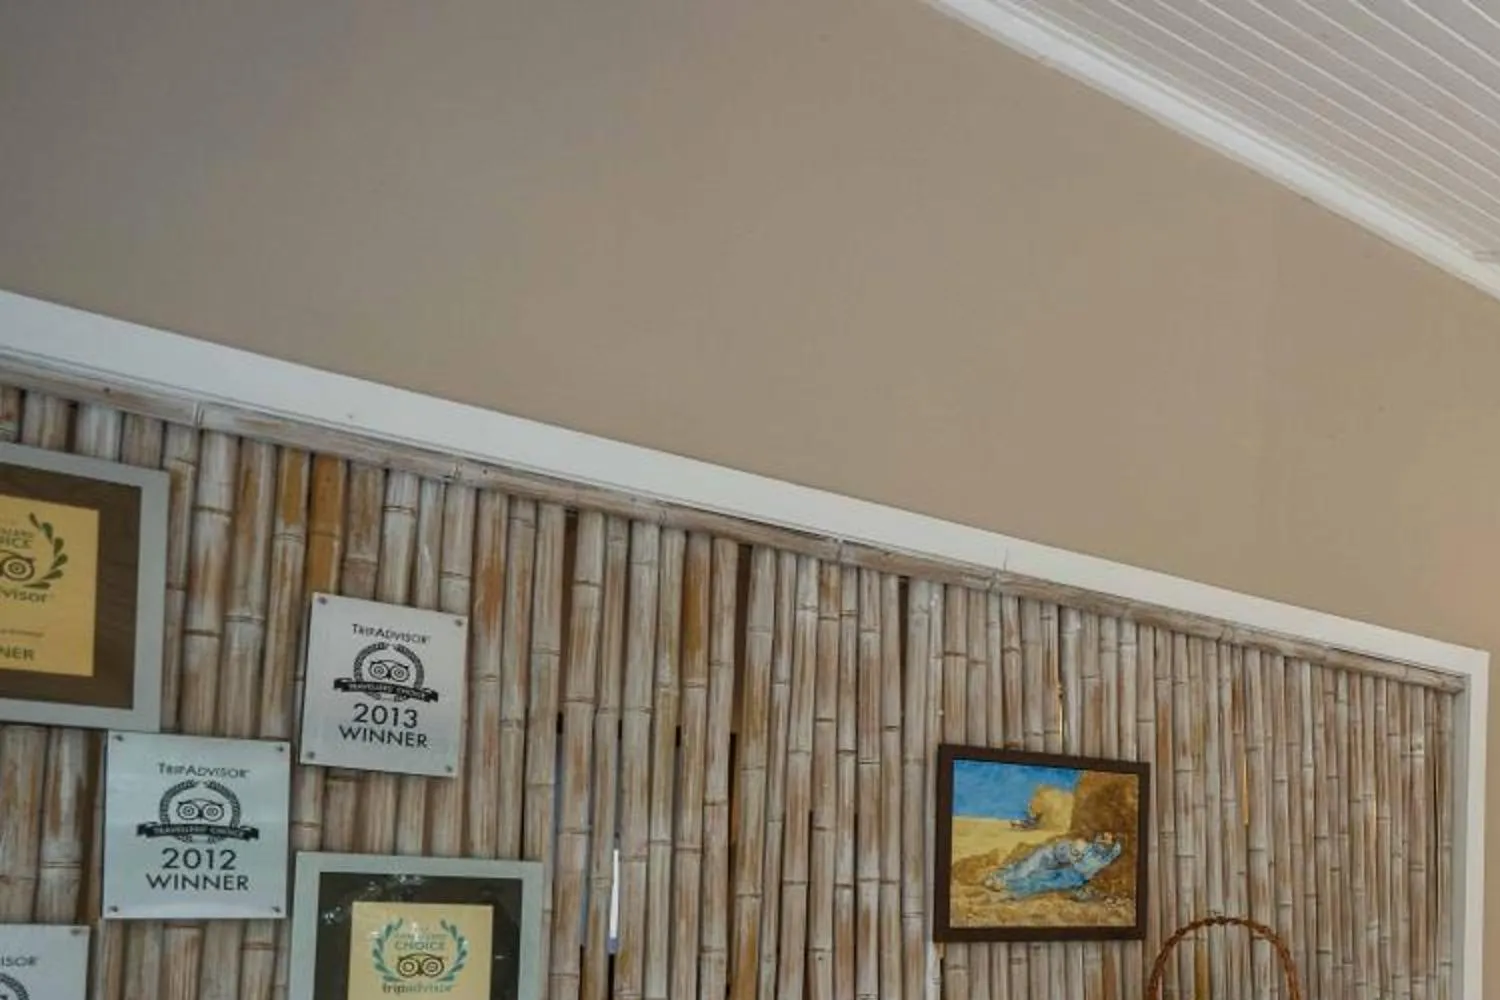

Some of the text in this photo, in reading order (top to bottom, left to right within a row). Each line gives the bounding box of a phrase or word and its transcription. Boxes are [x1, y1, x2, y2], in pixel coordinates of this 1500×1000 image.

[353, 702, 418, 729] 2013
[338, 724, 428, 748] WINNER
[162, 848, 236, 870] 2012
[146, 873, 249, 890] WINNER
